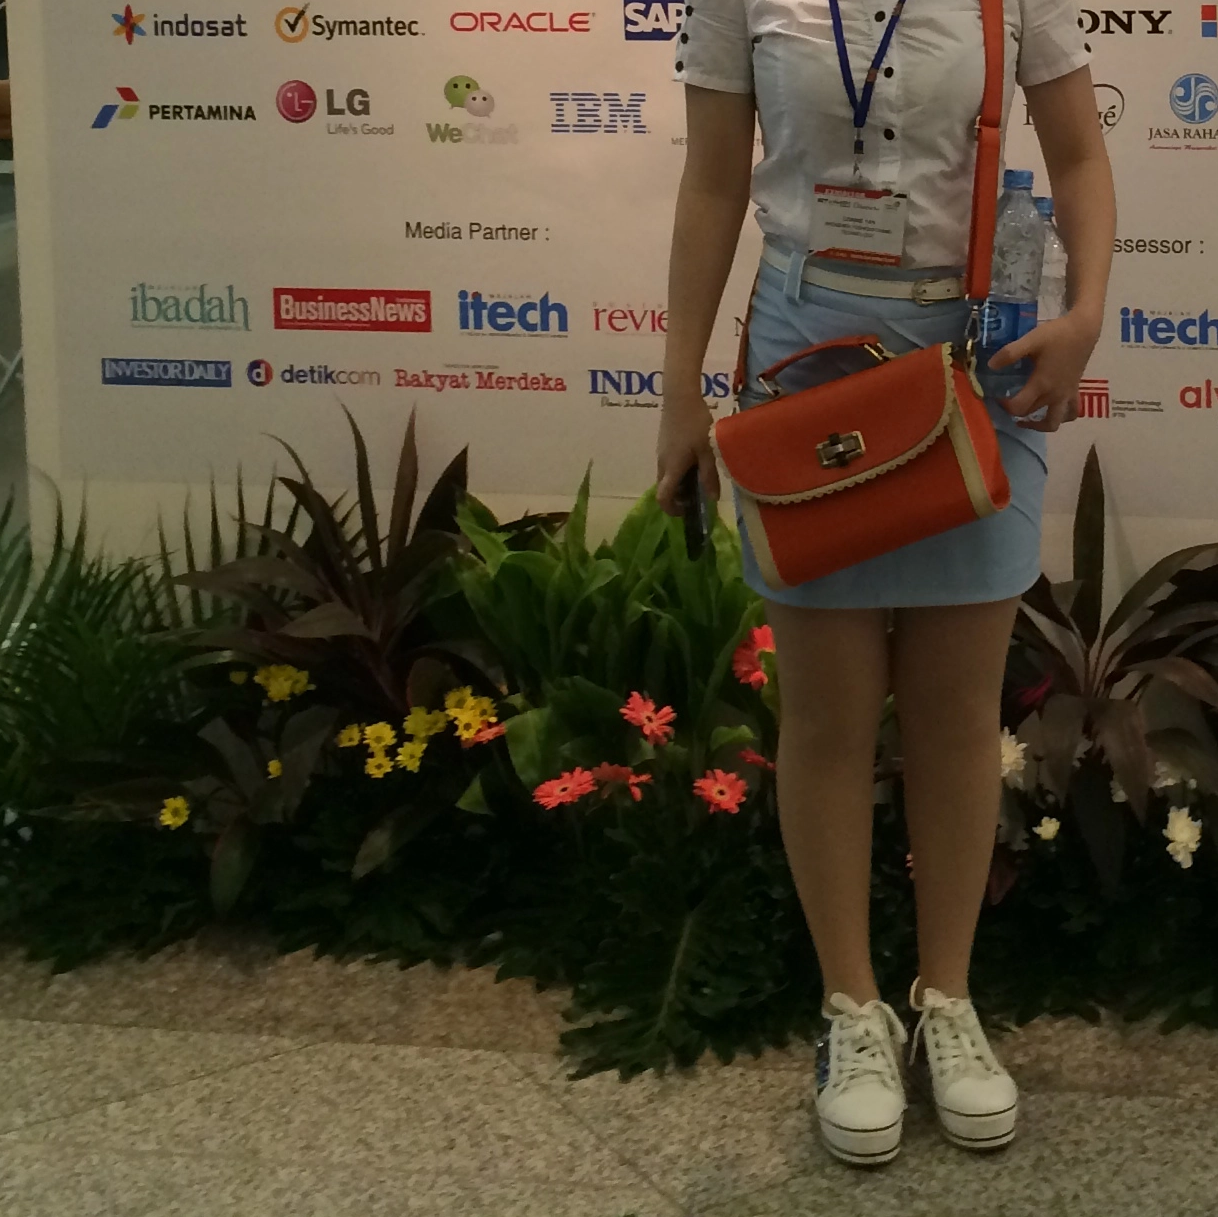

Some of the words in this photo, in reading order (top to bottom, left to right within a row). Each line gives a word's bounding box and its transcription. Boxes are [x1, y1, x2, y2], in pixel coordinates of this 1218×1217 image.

[153, 13, 248, 37] indosat
[450, 11, 591, 33] ORACLE
[623, 1, 685, 33] SAP
[1078, 9, 1172, 35] ONY
[148, 104, 257, 121] PERTAMINA
[325, 88, 371, 117] LG
[549, 92, 647, 134] IBM
[361, 123, 395, 136] Good
[425, 122, 519, 145] WeChat
[1148, 127, 1180, 141] JASA
[405, 221, 463, 240] Media
[469, 222, 539, 242] Partner
[1112, 236, 1192, 254] ssessor
[129, 282, 252, 332] ibadah
[279, 293, 426, 323] BusinessNews
[458, 289, 568, 332] itech
[593, 308, 669, 333] revie
[280, 364, 381, 386] detikcom
[394, 369, 469, 393] Rakyat
[475, 371, 568, 392] Merdeka
